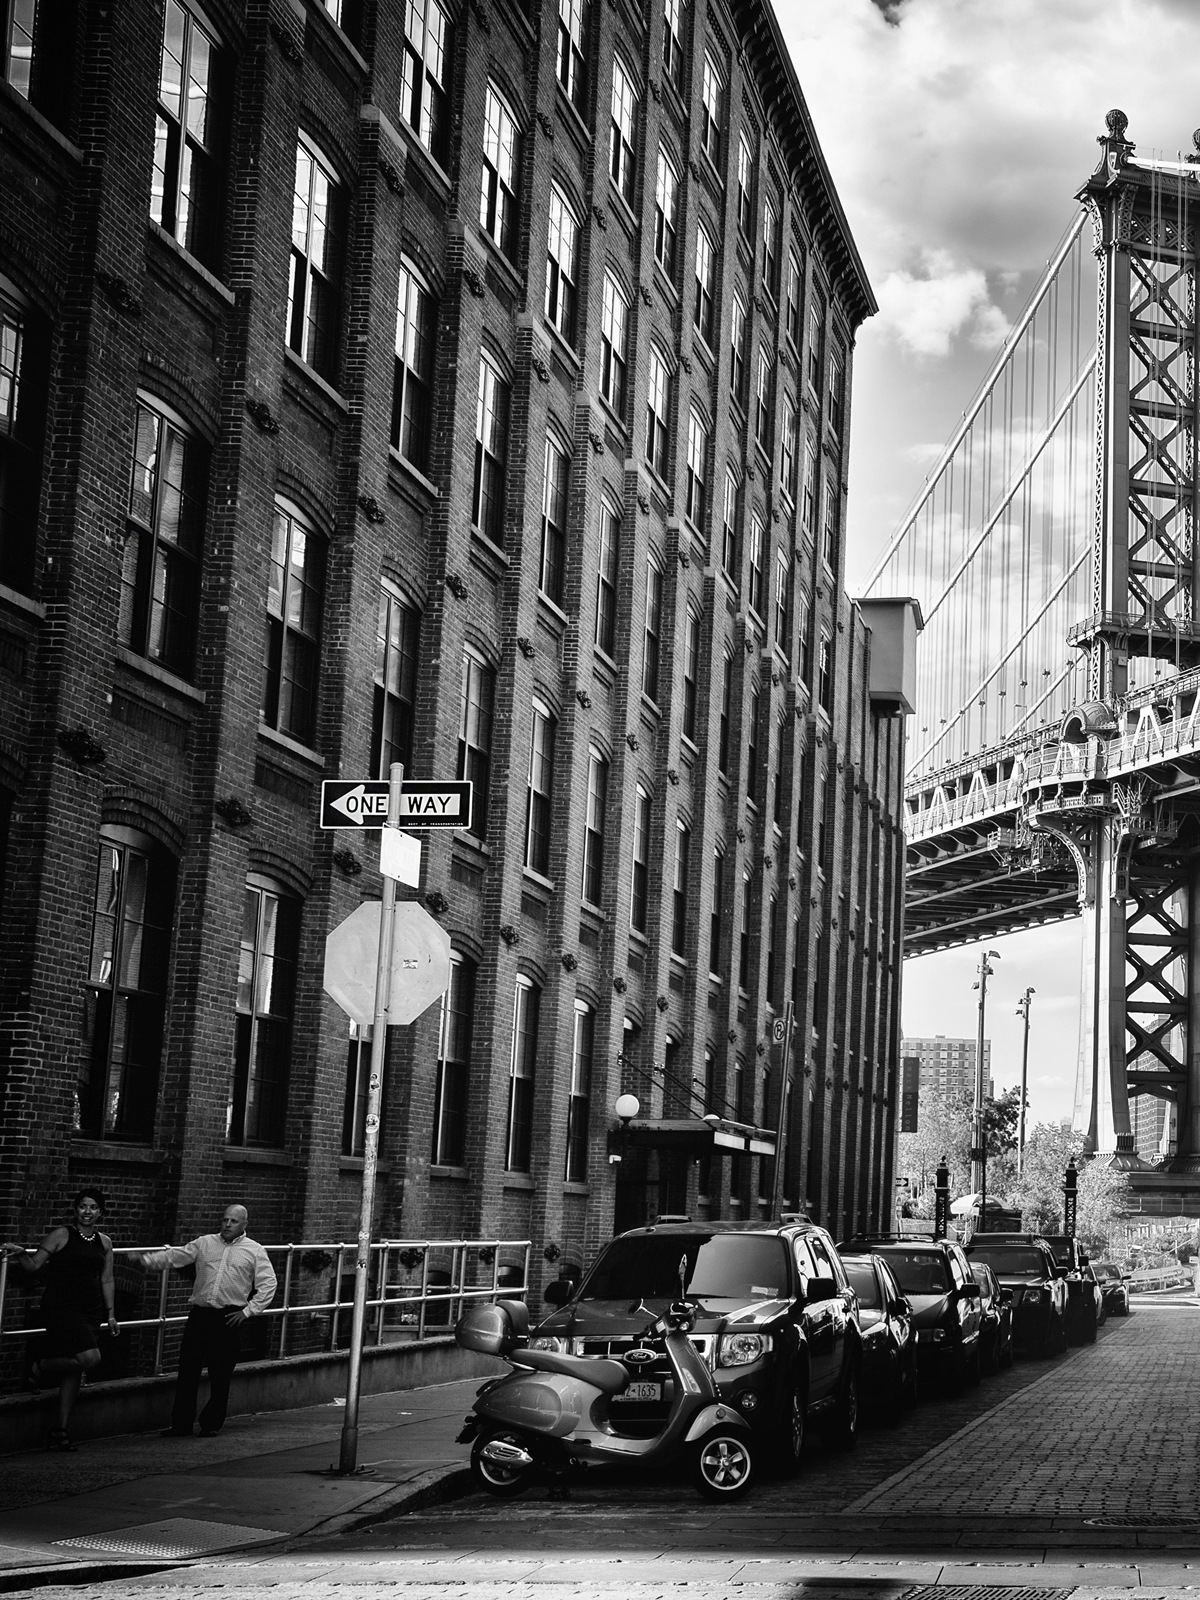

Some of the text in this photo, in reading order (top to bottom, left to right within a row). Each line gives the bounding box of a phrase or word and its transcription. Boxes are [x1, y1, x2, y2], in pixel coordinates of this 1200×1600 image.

[346, 796, 452, 813] ONE WAY
[906, 1060, 914, 1091] Smack
[905, 1094, 913, 1131] Mellon
